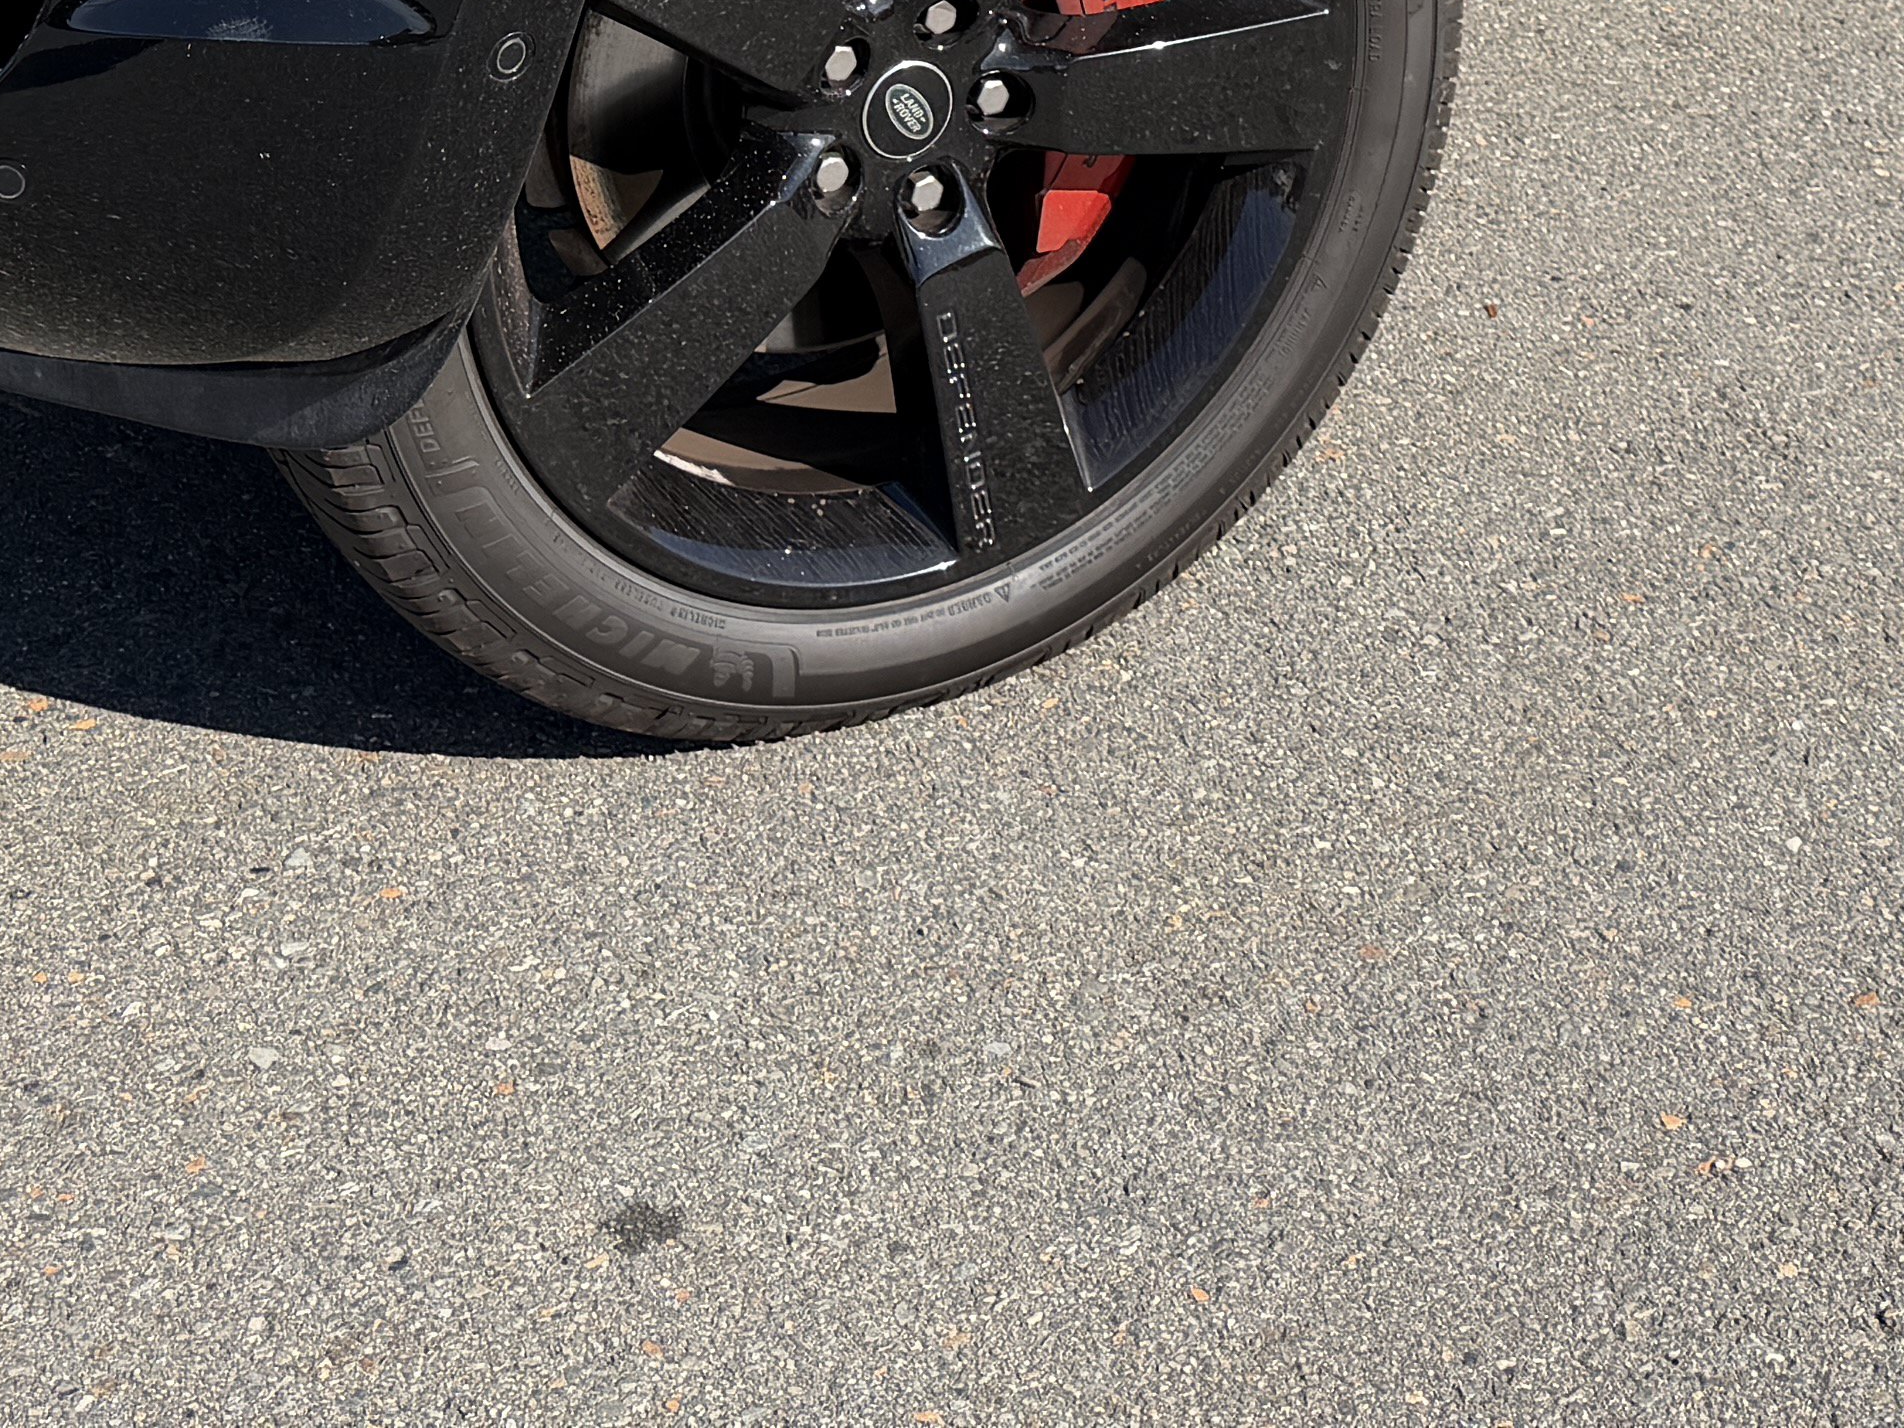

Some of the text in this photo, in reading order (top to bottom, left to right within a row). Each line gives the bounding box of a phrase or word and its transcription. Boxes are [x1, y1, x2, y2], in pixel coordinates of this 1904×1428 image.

[894, 104, 922, 132] ROVER
[900, 94, 924, 119] LAND
[937, 311, 996, 552] DEFENDER
[452, 504, 702, 676] MICHELIN
